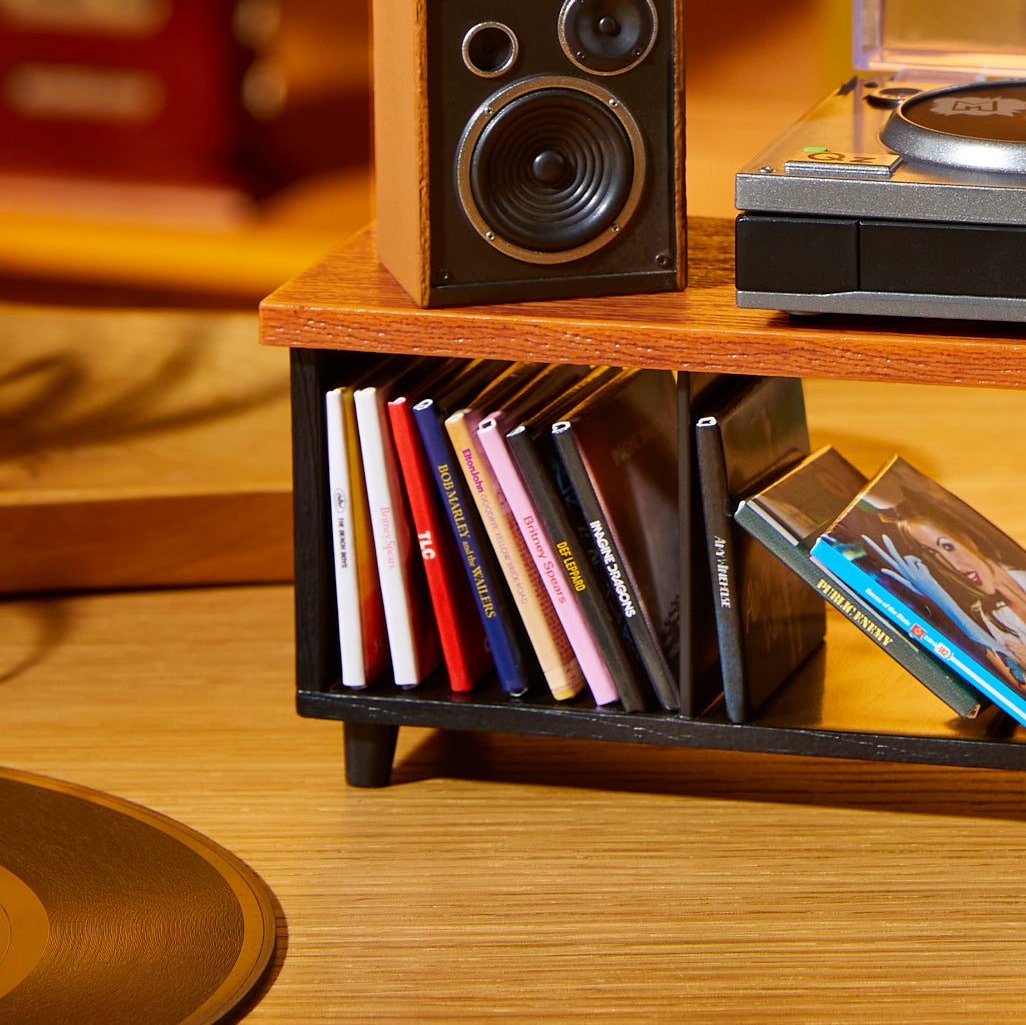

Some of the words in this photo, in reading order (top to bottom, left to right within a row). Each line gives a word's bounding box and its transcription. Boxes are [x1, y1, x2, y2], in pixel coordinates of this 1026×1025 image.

[437, 464, 453, 490] BOB
[380, 507, 393, 539] Britney
[447, 490, 471, 538] MARLEY
[338, 529, 346, 549] BEACH
[384, 541, 398, 569] Spears
[417, 531, 436, 560] TLC
[462, 540, 472, 555] and
[480, 494, 498, 530] GOODBYE
[495, 532, 511, 560] YELLOW
[515, 582, 528, 605] ROAD
[467, 553, 478, 567] the
[523, 515, 548, 559] Britney
[544, 562, 567, 604] Spears
[556, 541, 570, 557] DEF
[563, 557, 586, 592] LEPPARD
[589, 520, 616, 565] IMAGINE
[607, 563, 637, 618] DRAGONS
[471, 566, 496, 619] WAILERS
[816, 578, 856, 615] PUBLIC
[853, 610, 893, 647] ENEMY
